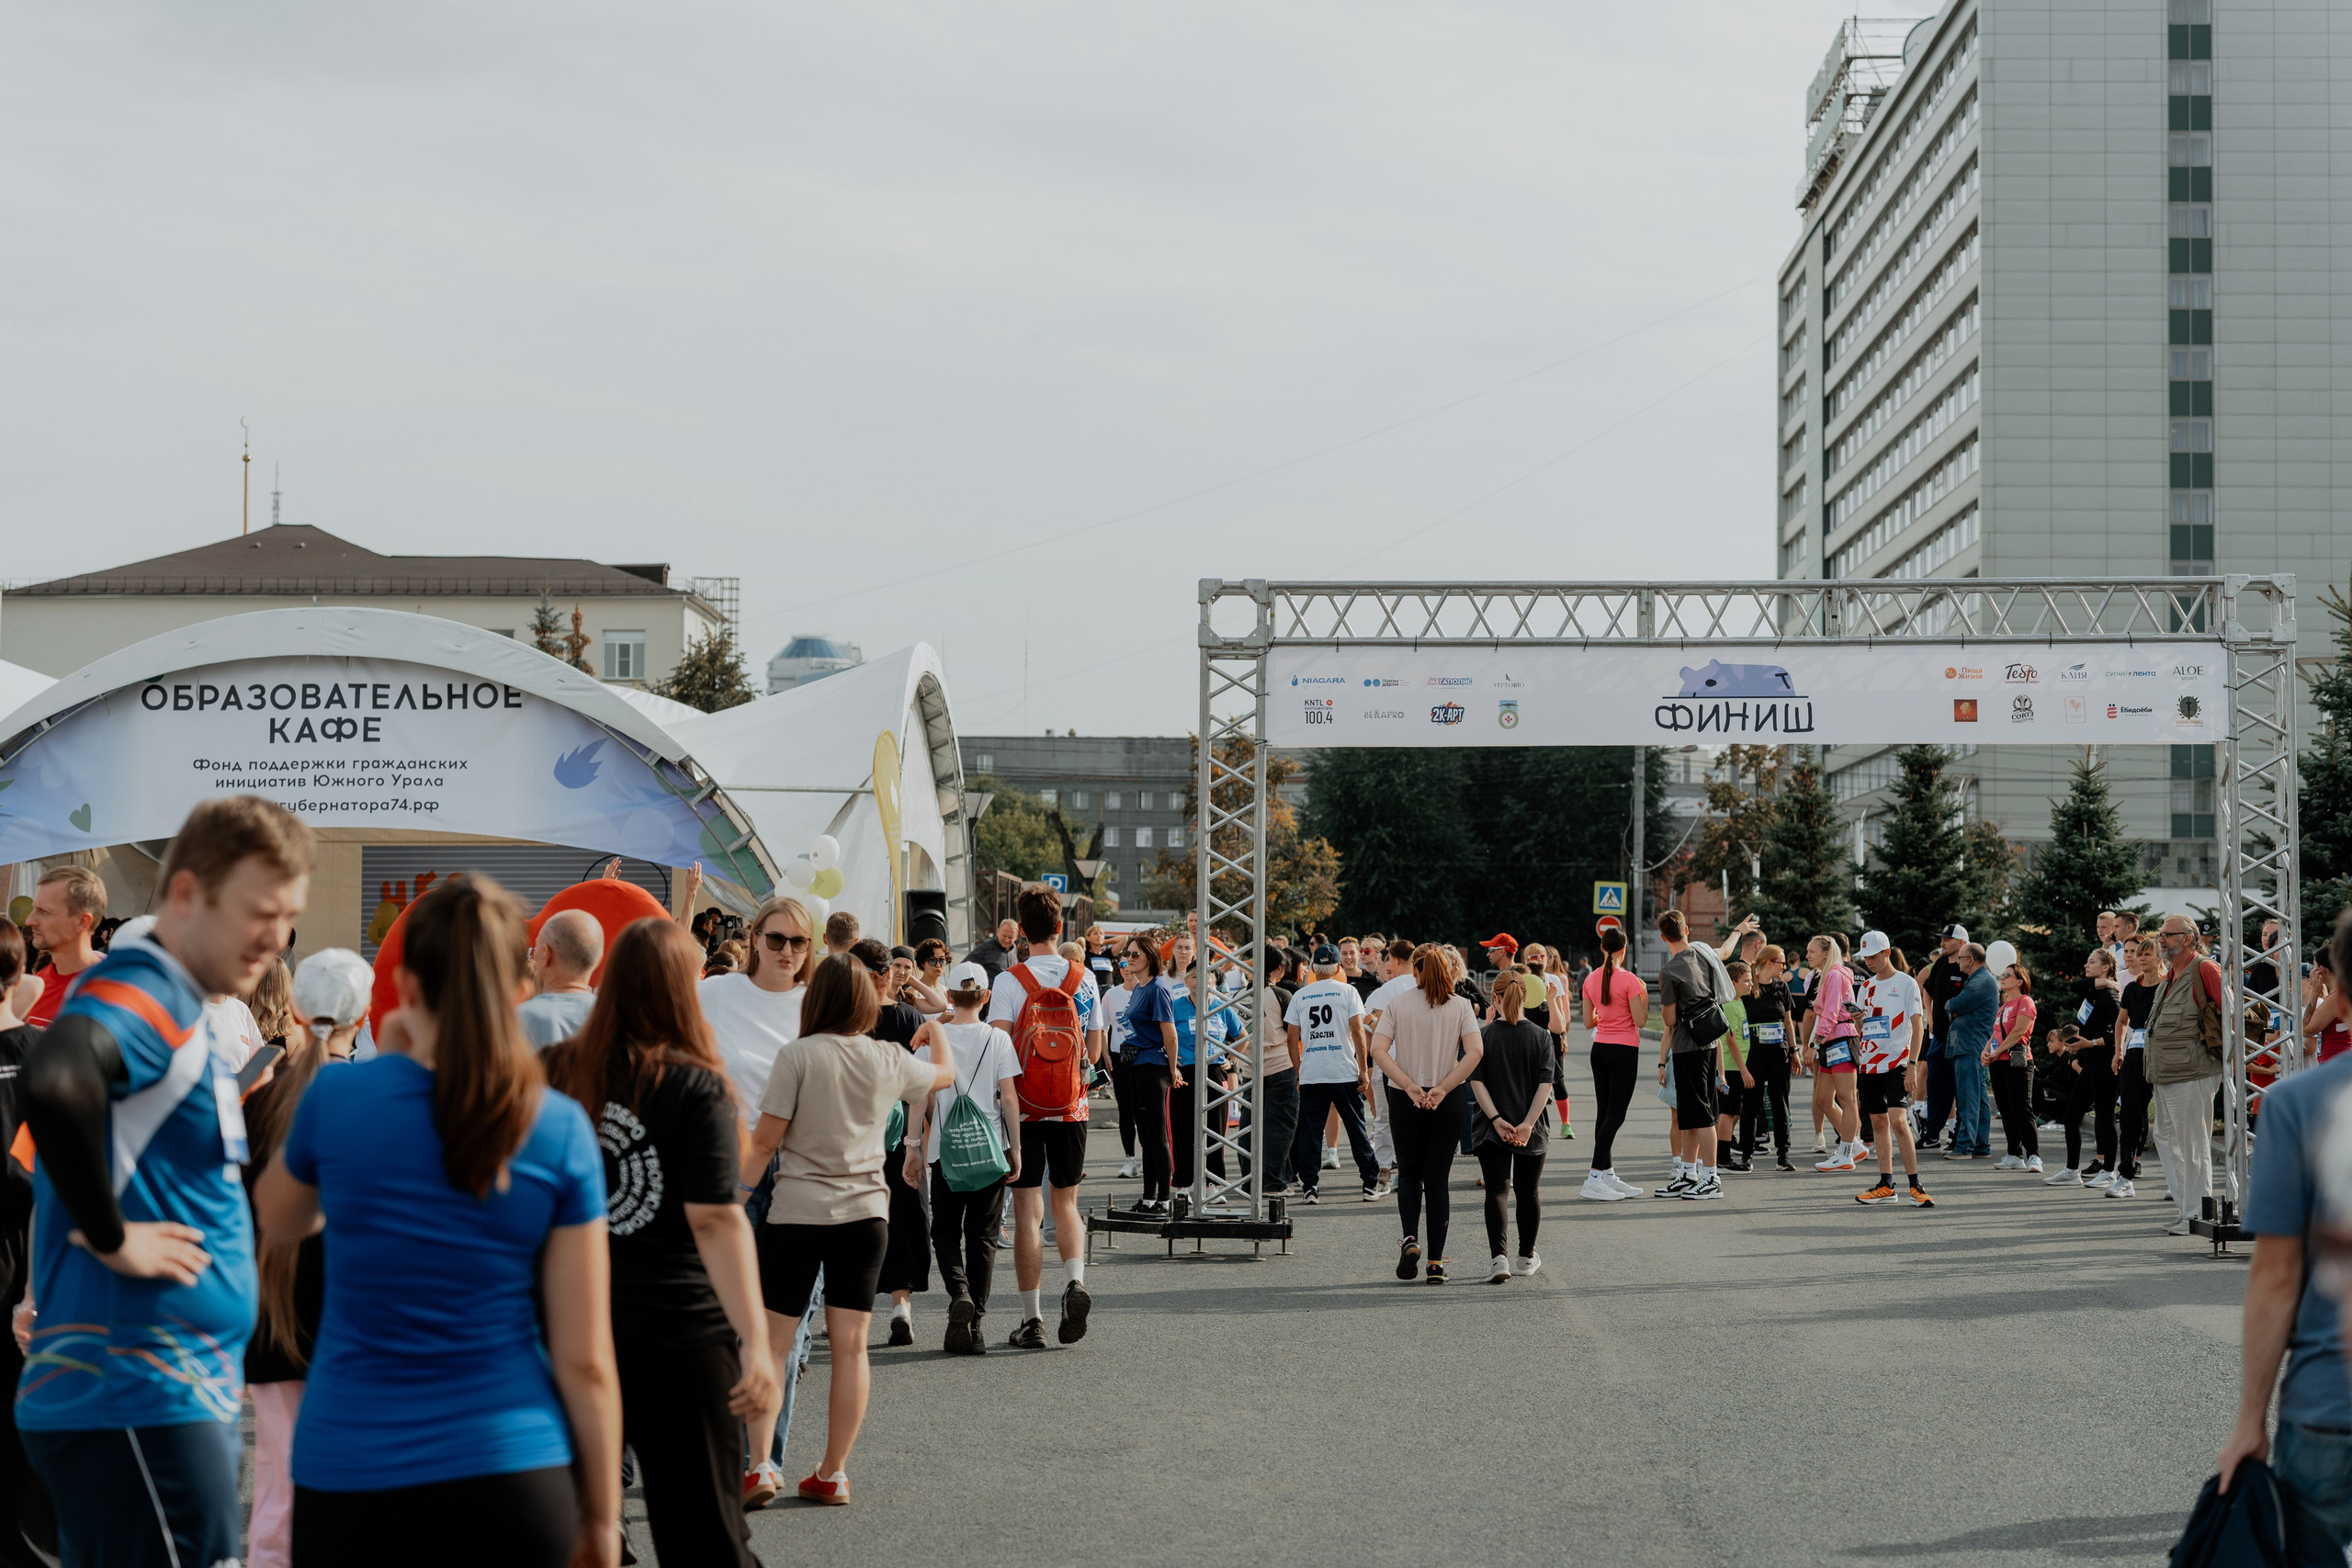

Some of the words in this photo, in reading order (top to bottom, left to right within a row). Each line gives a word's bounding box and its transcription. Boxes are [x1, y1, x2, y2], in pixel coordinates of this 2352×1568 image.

[2172, 665, 2204, 676] ALOE
[1427, 677, 1473, 686] МЕГАПОЛИС
[141, 682, 522, 711] ОБРАЗОВАТЕЛЬНОЕ
[1305, 711, 1333, 724] 100.4
[1655, 701, 1815, 733] ФИНИШ
[269, 716, 381, 743] КАФЕ
[193, 759, 242, 772] Фонд
[249, 760, 345, 773] поддержки
[353, 760, 468, 772] гражданских
[215, 778, 306, 789] инициатив
[313, 774, 385, 787] Южного
[391, 773, 444, 789] Урала
[1308, 1004, 1333, 1029] 50
[1309, 1031, 1335, 1040] Касли
[601, 1101, 646, 1141] ДОБРО
